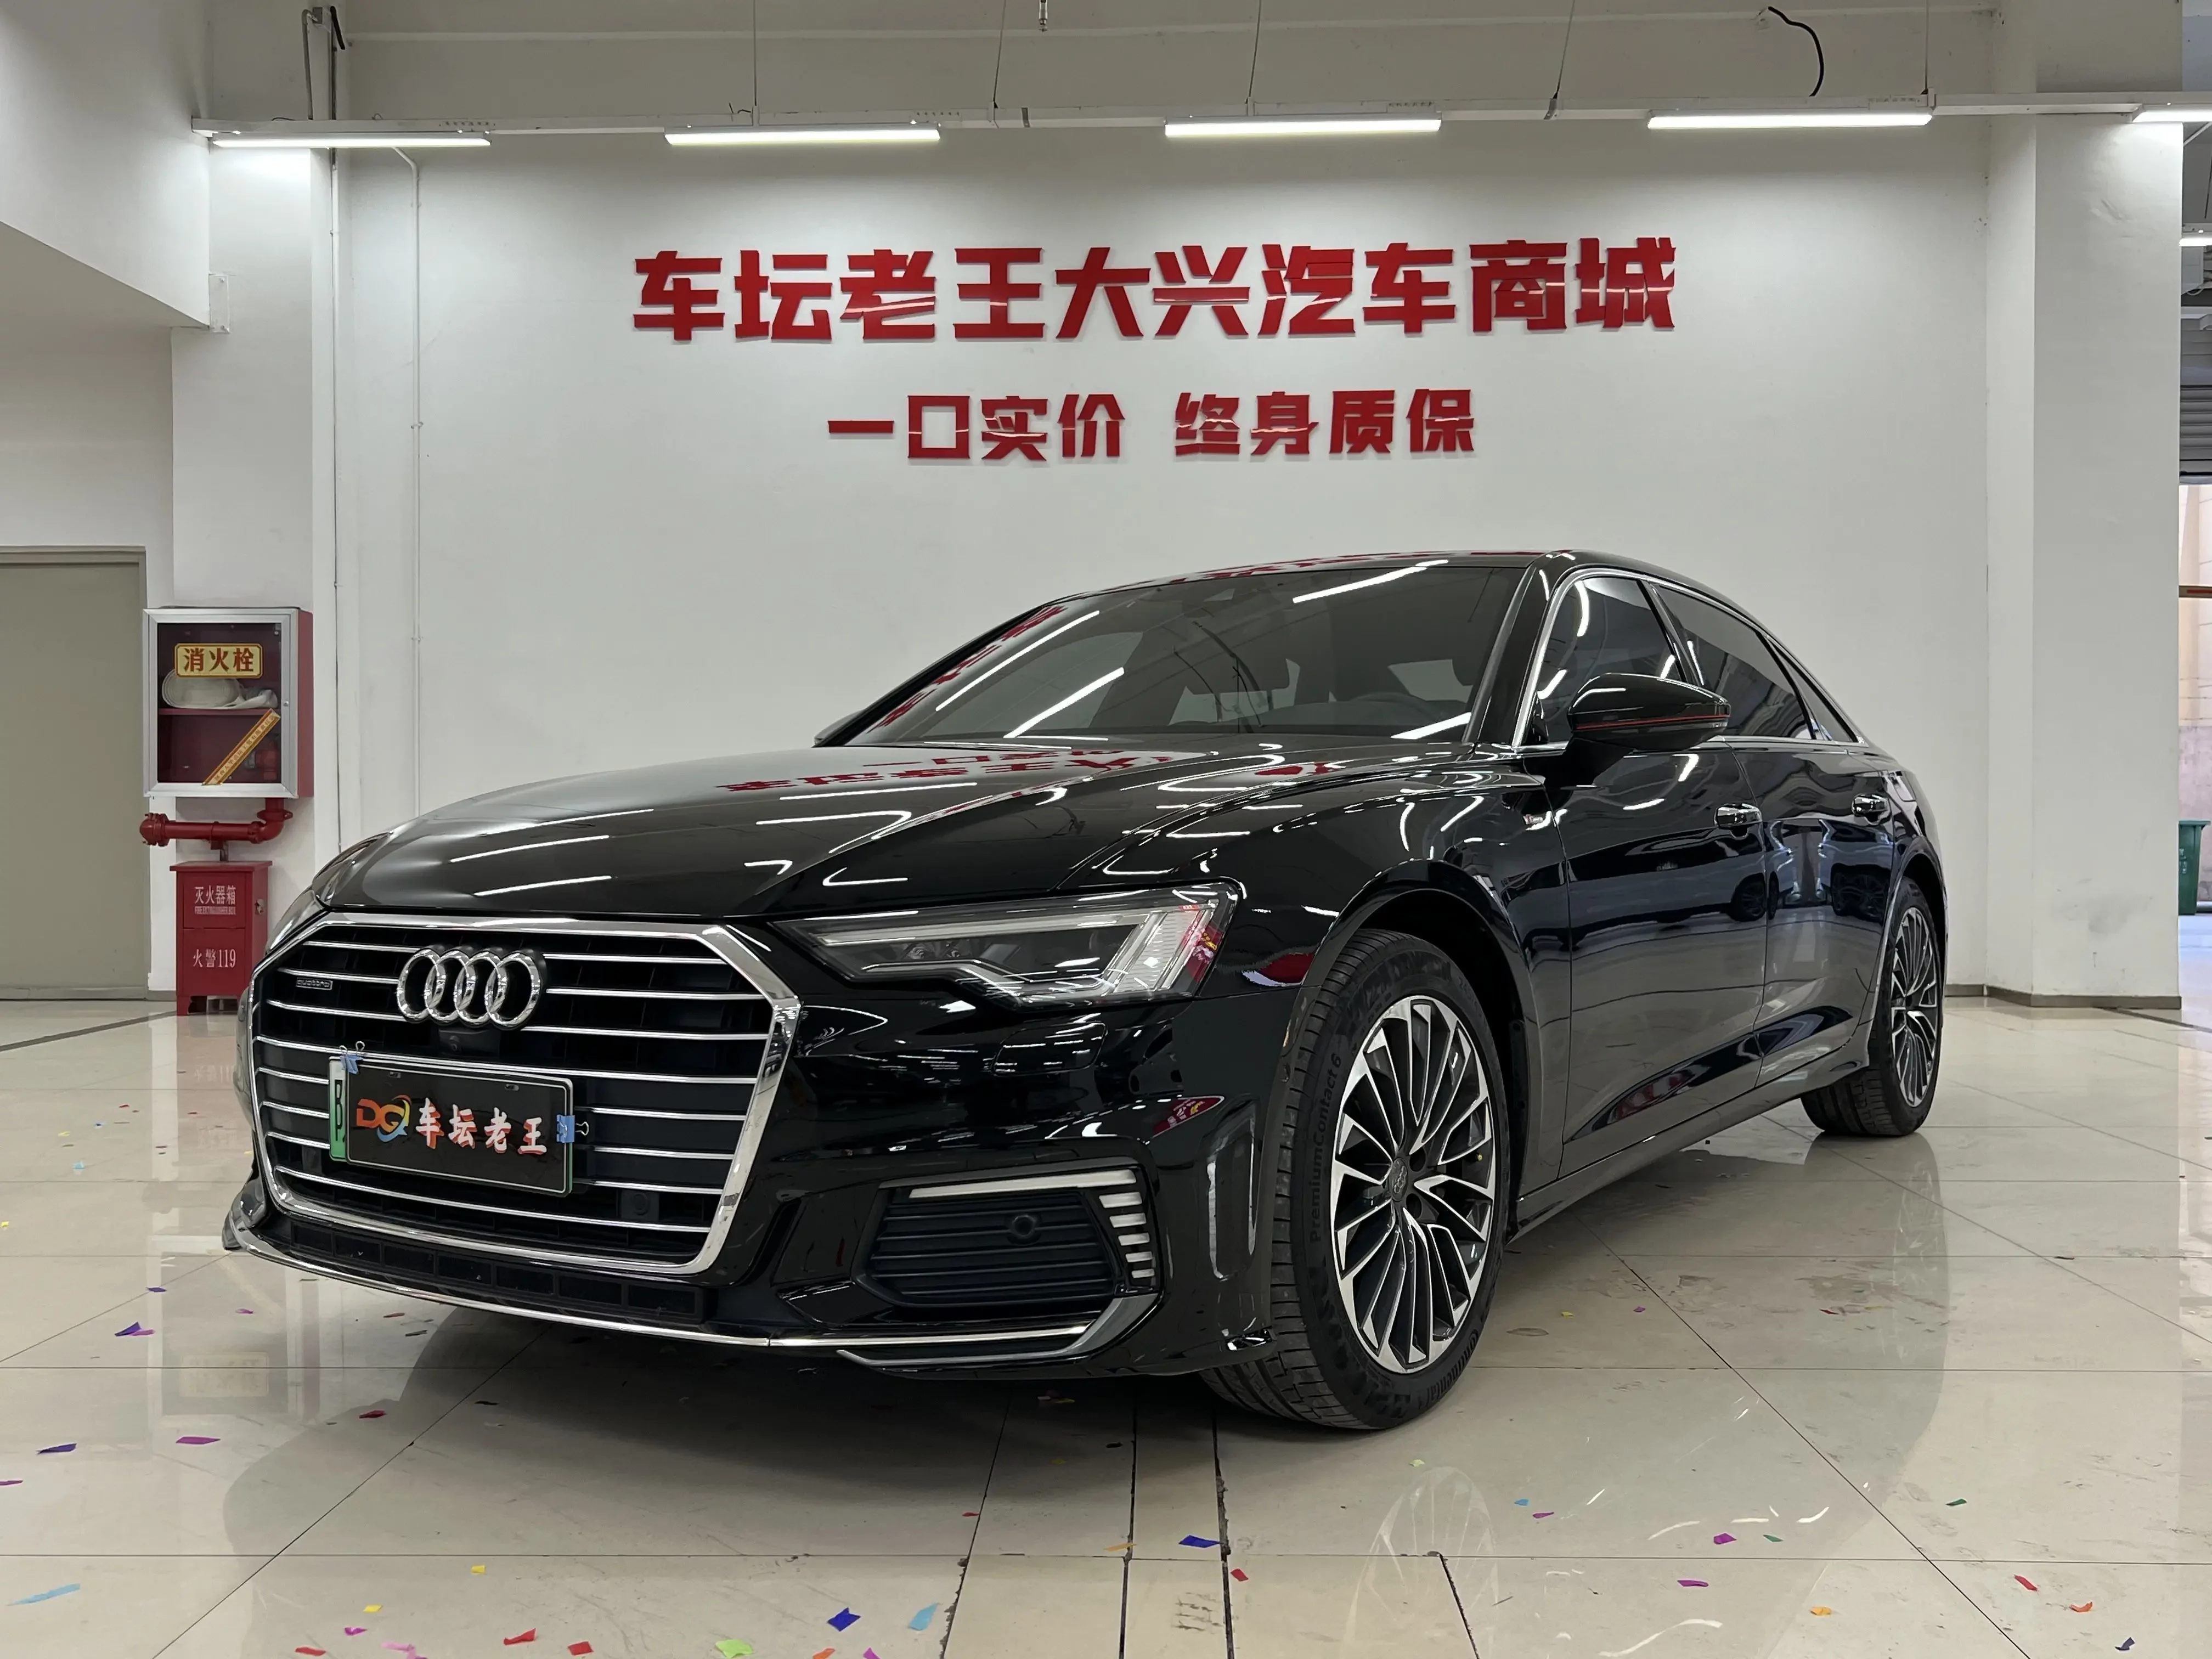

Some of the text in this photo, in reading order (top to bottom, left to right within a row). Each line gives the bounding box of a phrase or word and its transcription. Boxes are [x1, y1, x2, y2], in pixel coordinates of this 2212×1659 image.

[634, 237, 1675, 341] 车坛老王大兴汽车商城
[828, 388, 1475, 460] 一口实价 终身质保
[184, 647, 254, 672] 消火栓
[194, 885, 236, 905] 灭火器箱
[193, 949, 236, 968] 火警119
[415, 1097, 548, 1156] 车坛老王
[1310, 1052, 1342, 1243] PremiumContact 6
